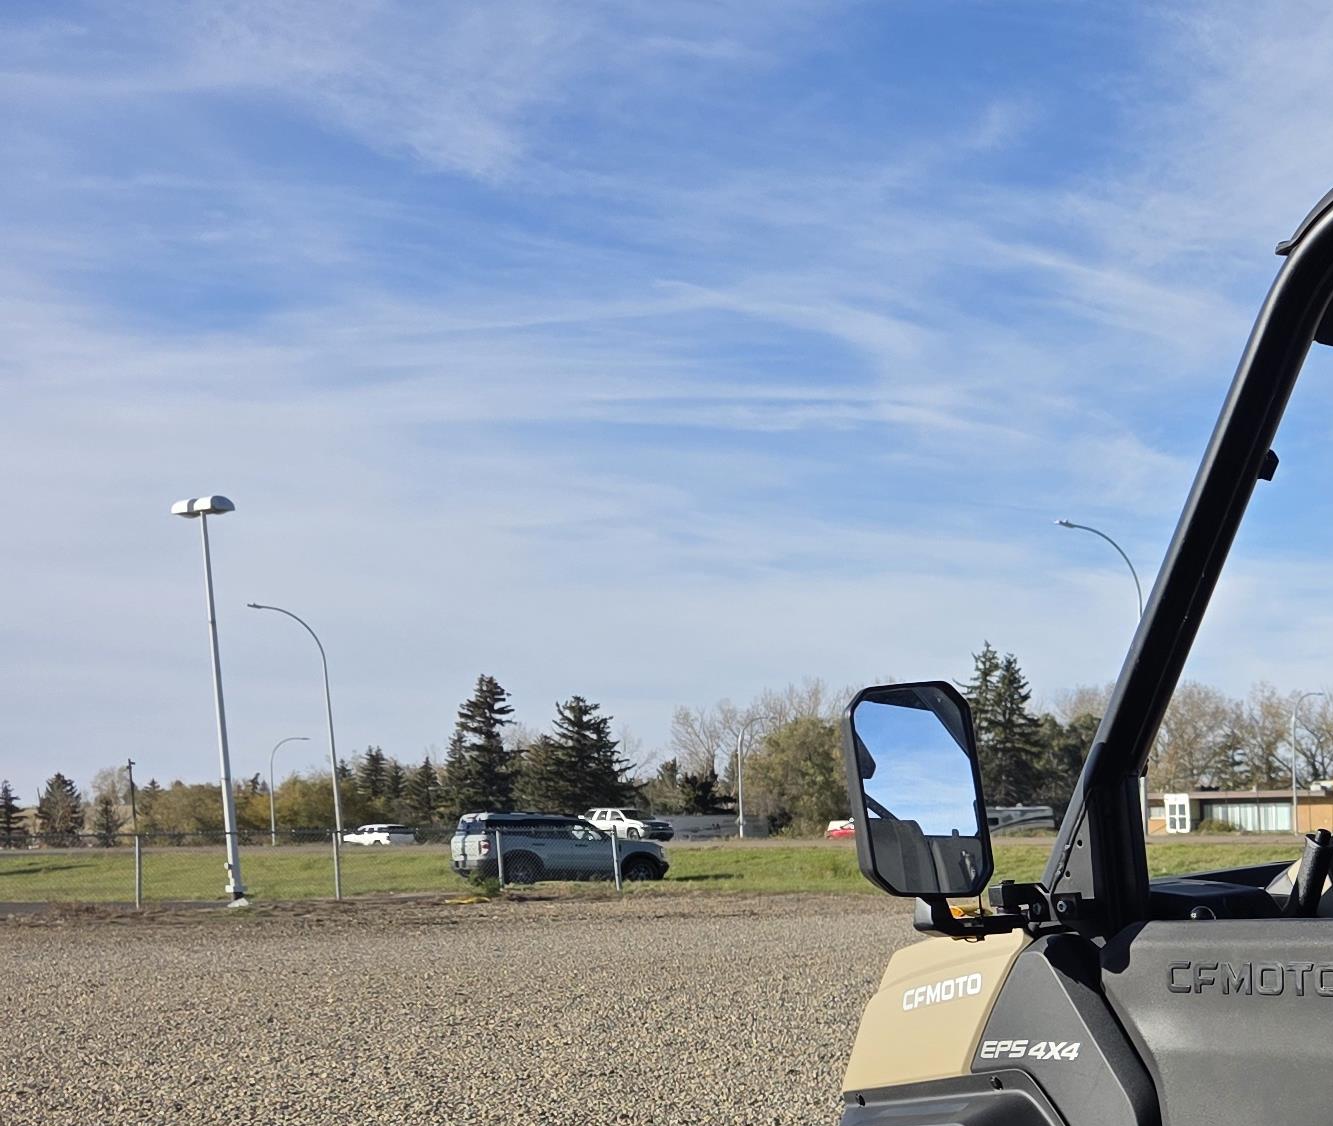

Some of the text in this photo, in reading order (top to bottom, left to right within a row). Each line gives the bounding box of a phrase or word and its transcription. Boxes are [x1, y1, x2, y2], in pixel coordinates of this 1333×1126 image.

[902, 973, 982, 1011] CFMOTO
[980, 1040, 1081, 1061] EPS 4X4
